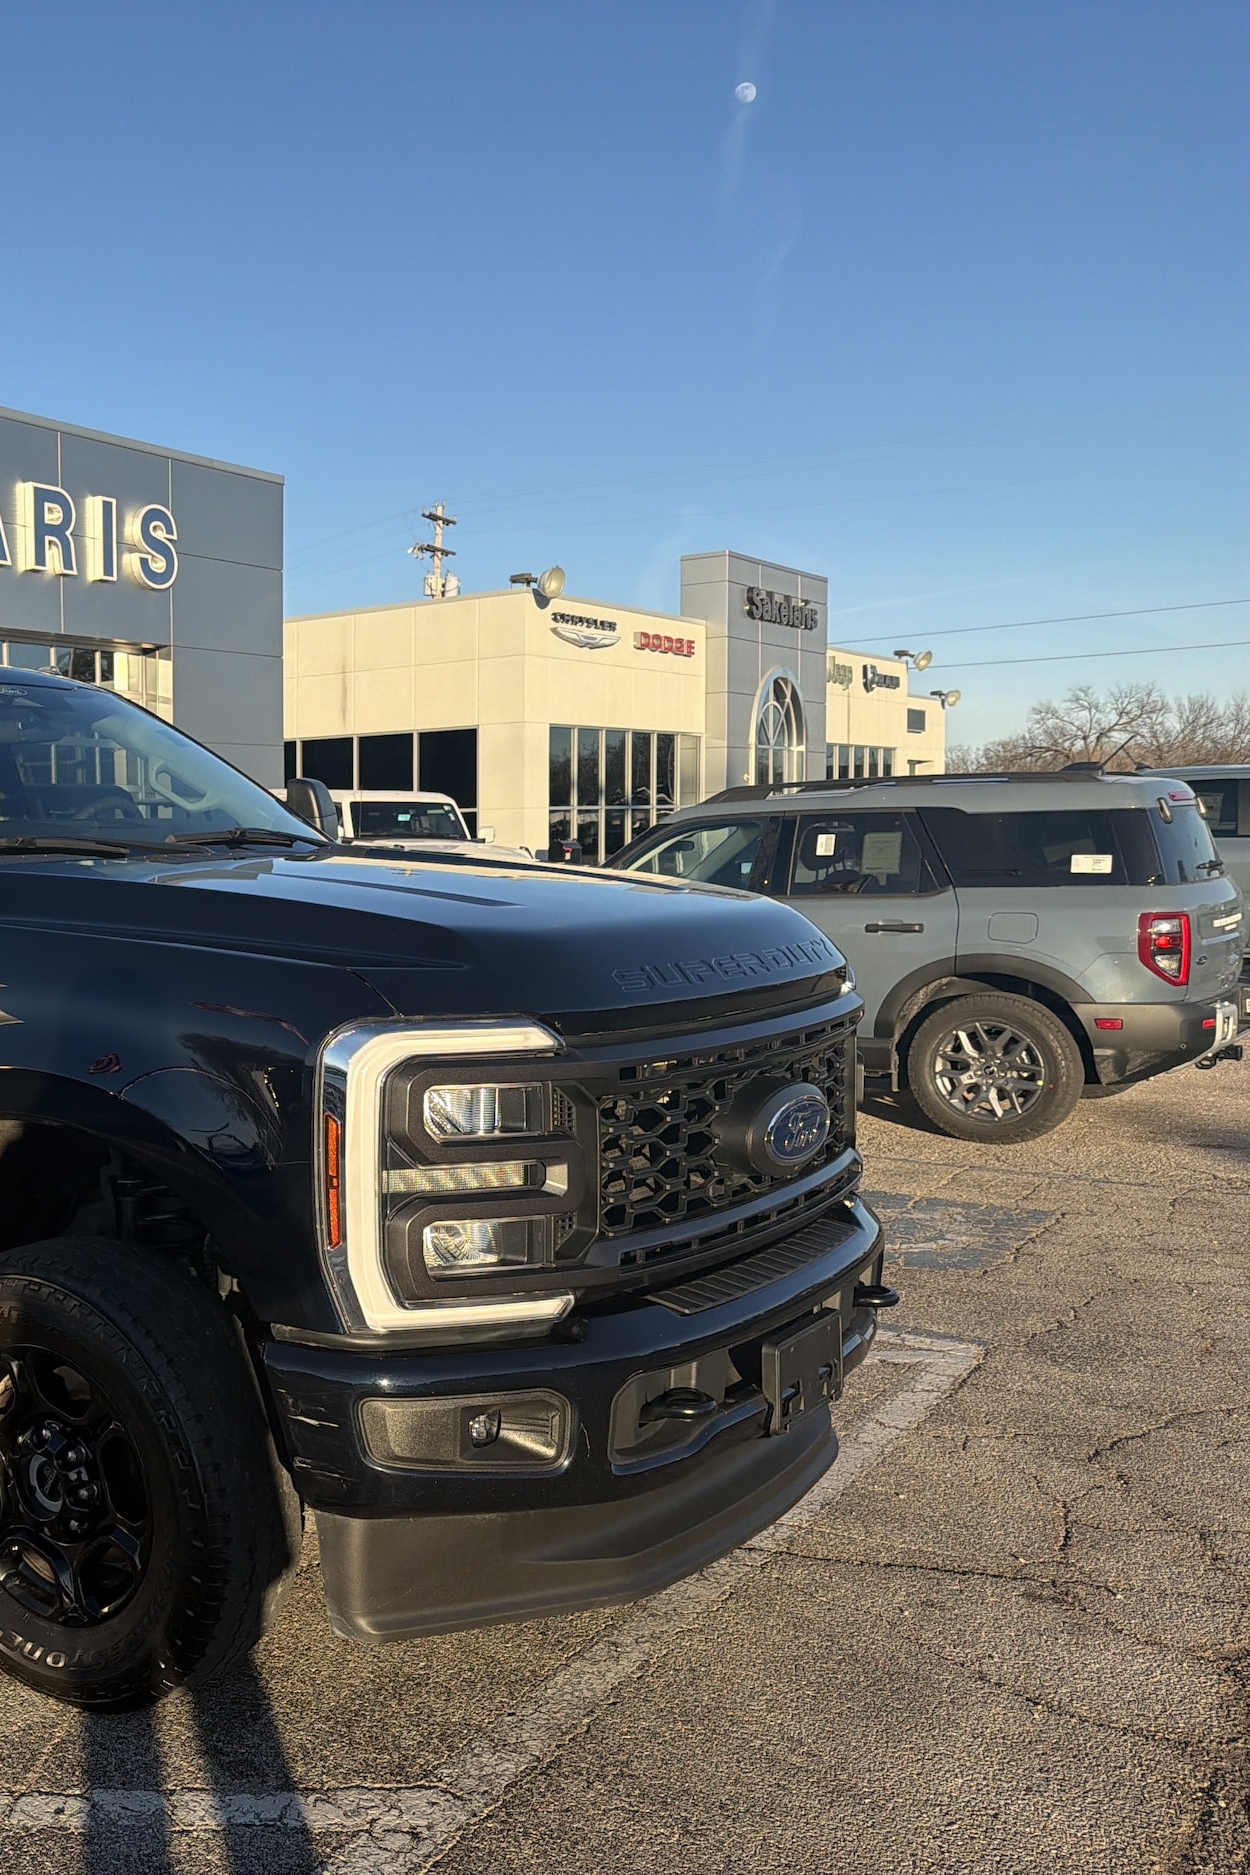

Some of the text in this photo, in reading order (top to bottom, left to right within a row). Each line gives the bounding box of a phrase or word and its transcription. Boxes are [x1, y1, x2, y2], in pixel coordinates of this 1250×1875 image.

[551, 612, 617, 632] CHRYSLER
[747, 587, 818, 630] Sakelaris
[636, 631, 695, 656] DODGE
[784, 1108, 822, 1152] Ford
